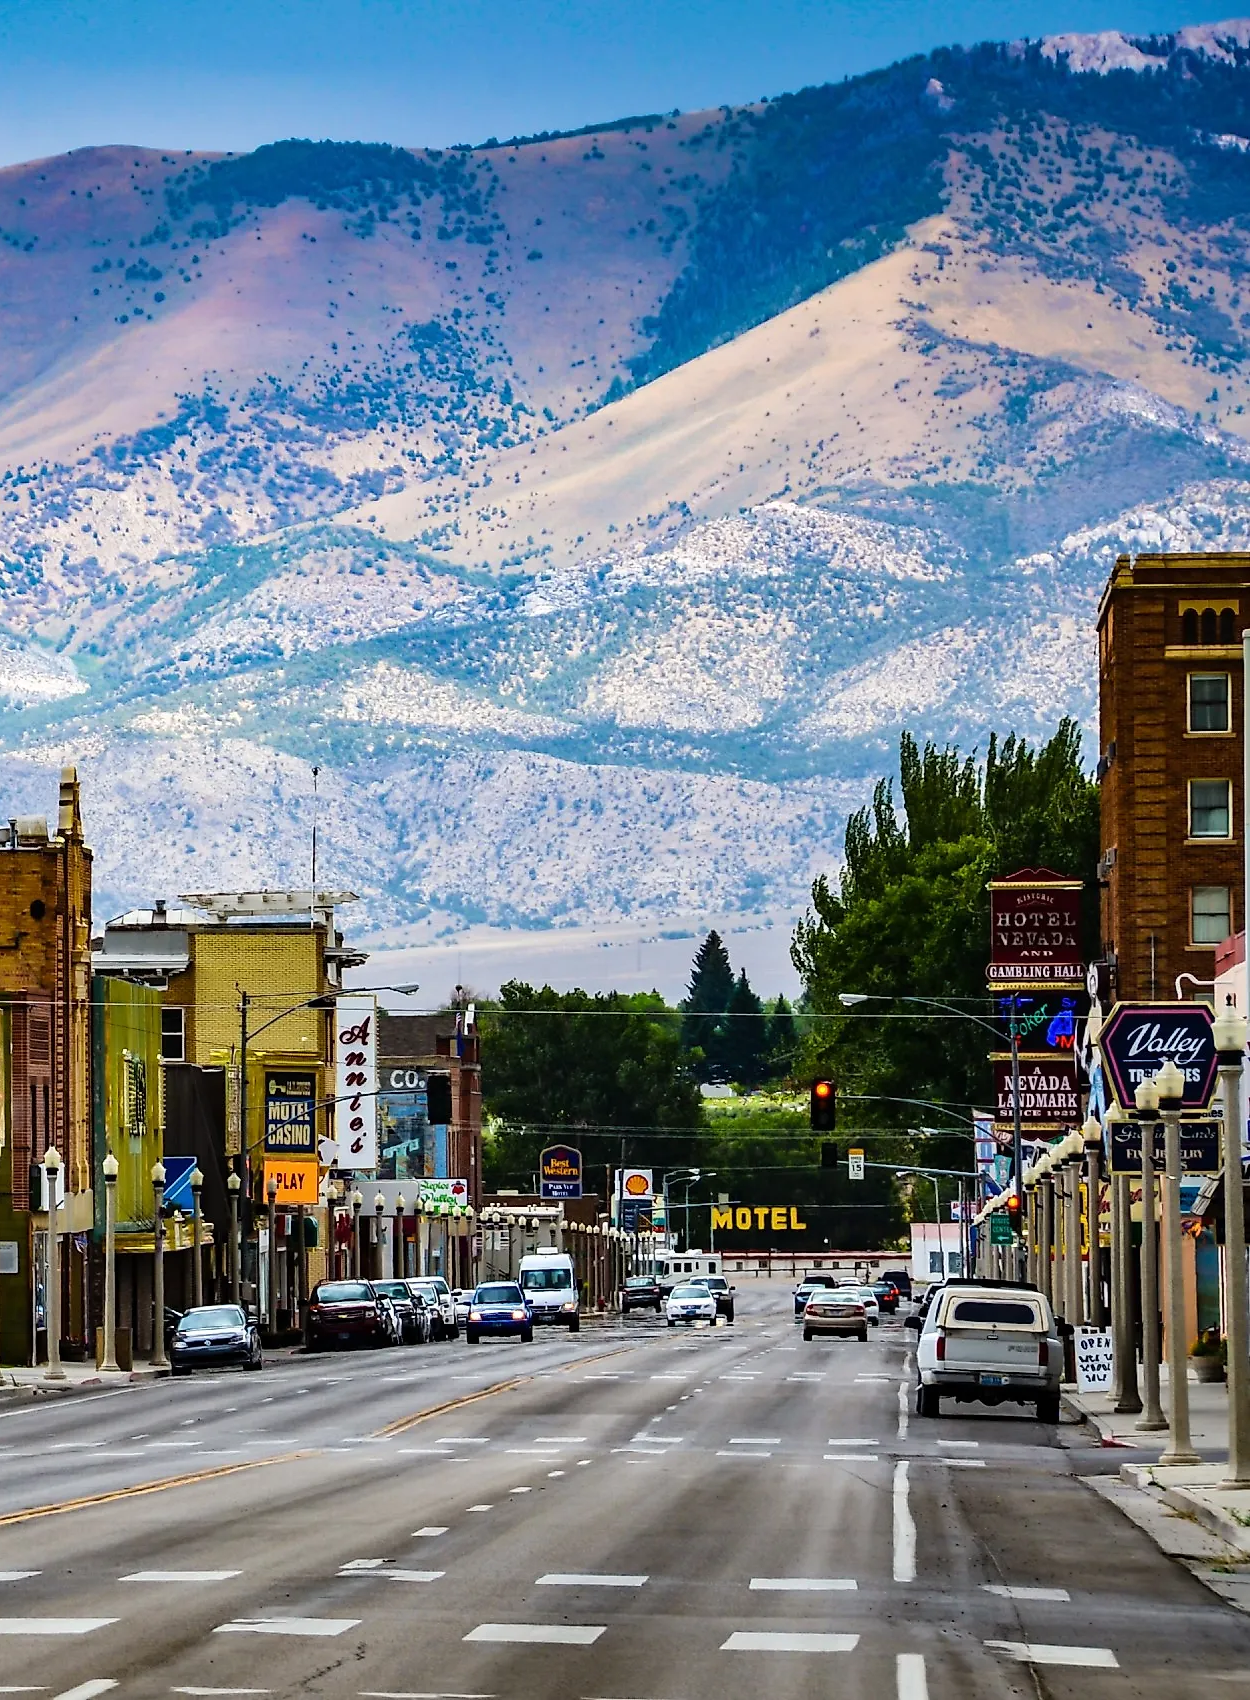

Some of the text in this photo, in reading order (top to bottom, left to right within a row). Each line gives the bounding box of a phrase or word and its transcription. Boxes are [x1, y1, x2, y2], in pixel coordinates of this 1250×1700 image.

[996, 912, 1076, 927] HOTEL
[997, 932, 1076, 946] NEVADA
[990, 966, 1084, 978] GAMBLING HALL
[1126, 1022, 1207, 1065] Valley
[1033, 1066, 1042, 1075] A
[339, 1016, 372, 1154] Annie's
[389, 1069, 426, 1089] CO.
[1003, 1075, 1071, 1091] NEVADA
[997, 1093, 1078, 1108] LANDMARK
[268, 1101, 310, 1121] MOTEL
[999, 1109, 1041, 1117] SICE
[268, 1123, 310, 1146] CASINO
[550, 1158, 570, 1168] Best
[851, 1164, 862, 1172] 15
[543, 1166, 579, 1176] Western
[276, 1172, 306, 1190] PLAY
[711, 1206, 807, 1230] MOTEL
[1080, 1337, 1111, 1350] OPEN
